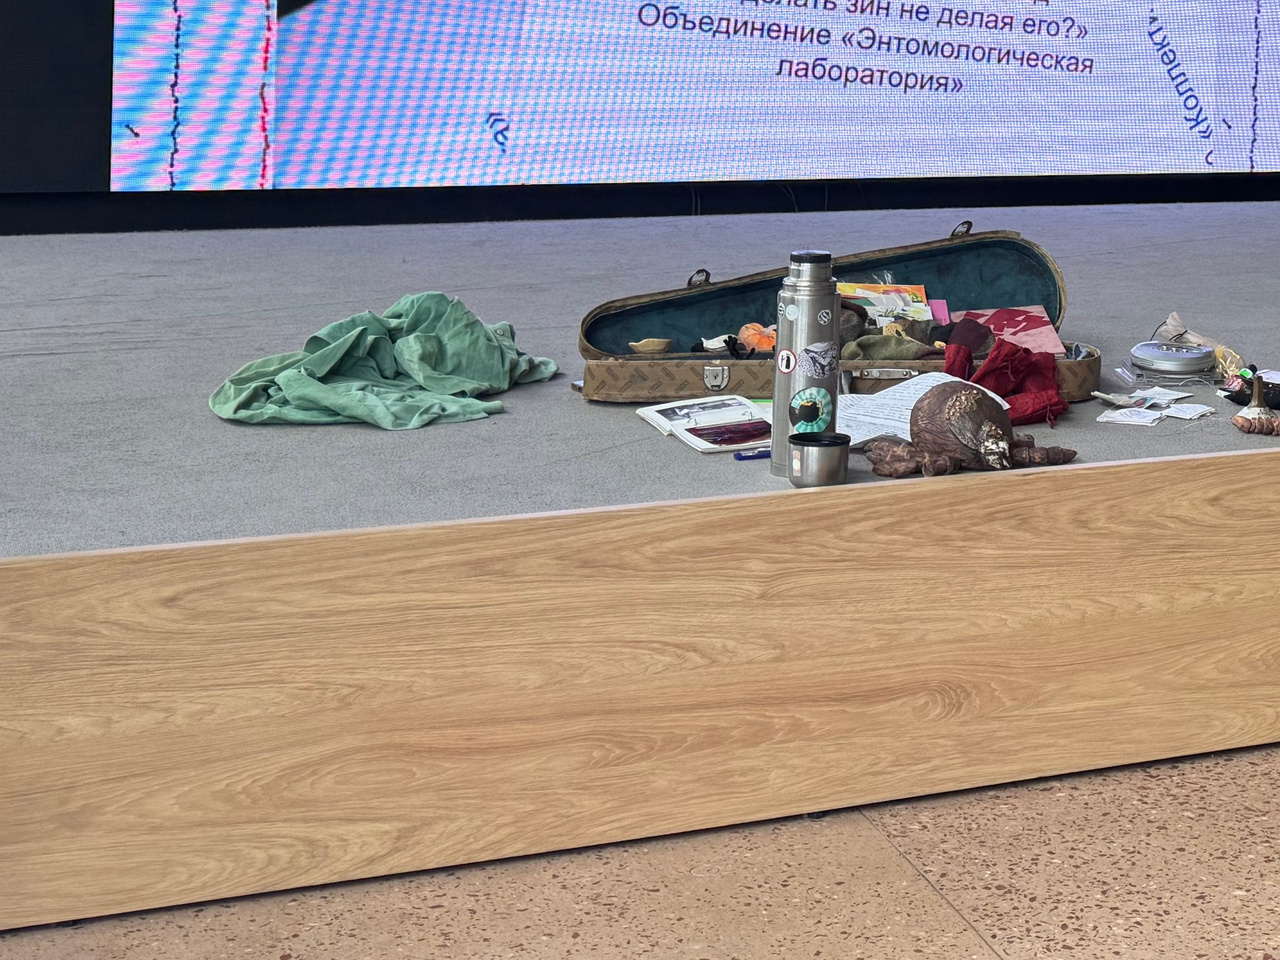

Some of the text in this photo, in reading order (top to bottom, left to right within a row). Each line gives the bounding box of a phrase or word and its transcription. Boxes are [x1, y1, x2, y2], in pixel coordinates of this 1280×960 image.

[637, 2, 1095, 75] Объединение «Энтомологическая
[899, 2, 931, 22] не
[936, 6, 1015, 32] делая
[1022, 16, 1089, 40] его?»
[774, 57, 964, 95] лаборатория»
[1147, 6, 1215, 140] «Коллект
